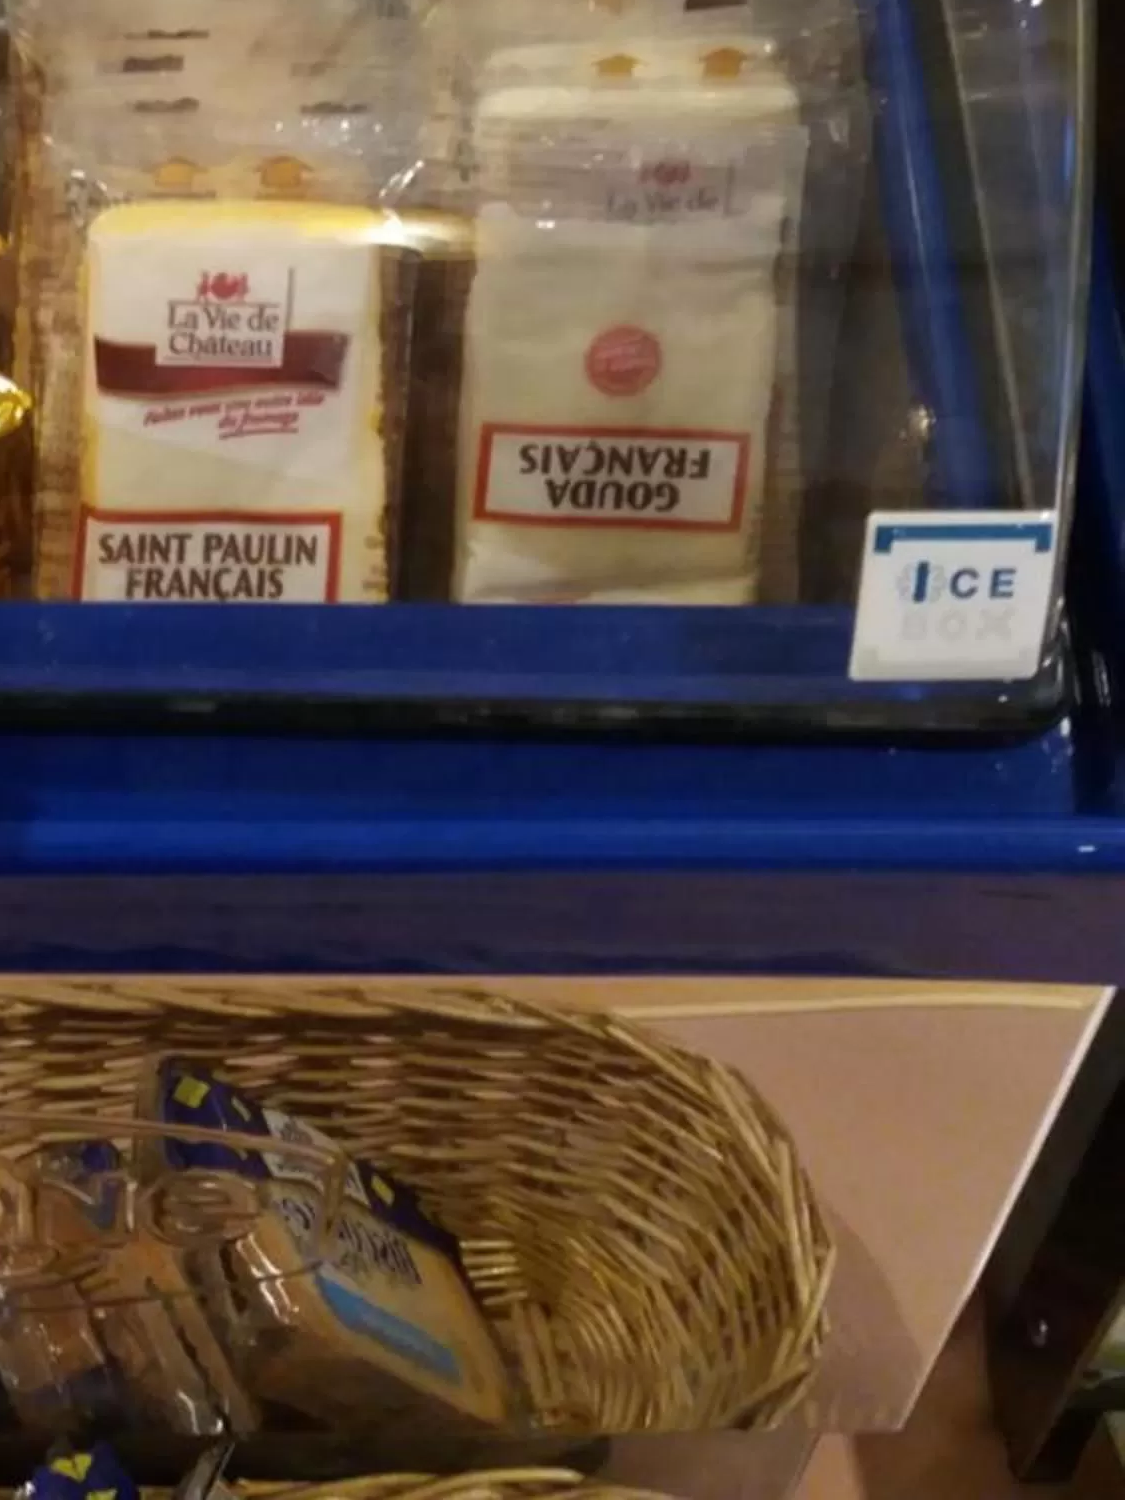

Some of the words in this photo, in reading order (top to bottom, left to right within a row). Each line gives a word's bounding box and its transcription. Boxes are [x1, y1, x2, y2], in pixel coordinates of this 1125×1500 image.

[167, 306, 199, 331] La
[201, 305, 243, 332] Vie
[246, 306, 280, 332] de
[168, 331, 273, 358] Château
[517, 440, 713, 481] FRANÇAIS
[543, 478, 682, 513] GOUDA
[97, 531, 193, 565] SAINT
[202, 533, 319, 566] PAULIN
[124, 566, 285, 600] FRANÇAIS
[911, 560, 1018, 604] ICE
